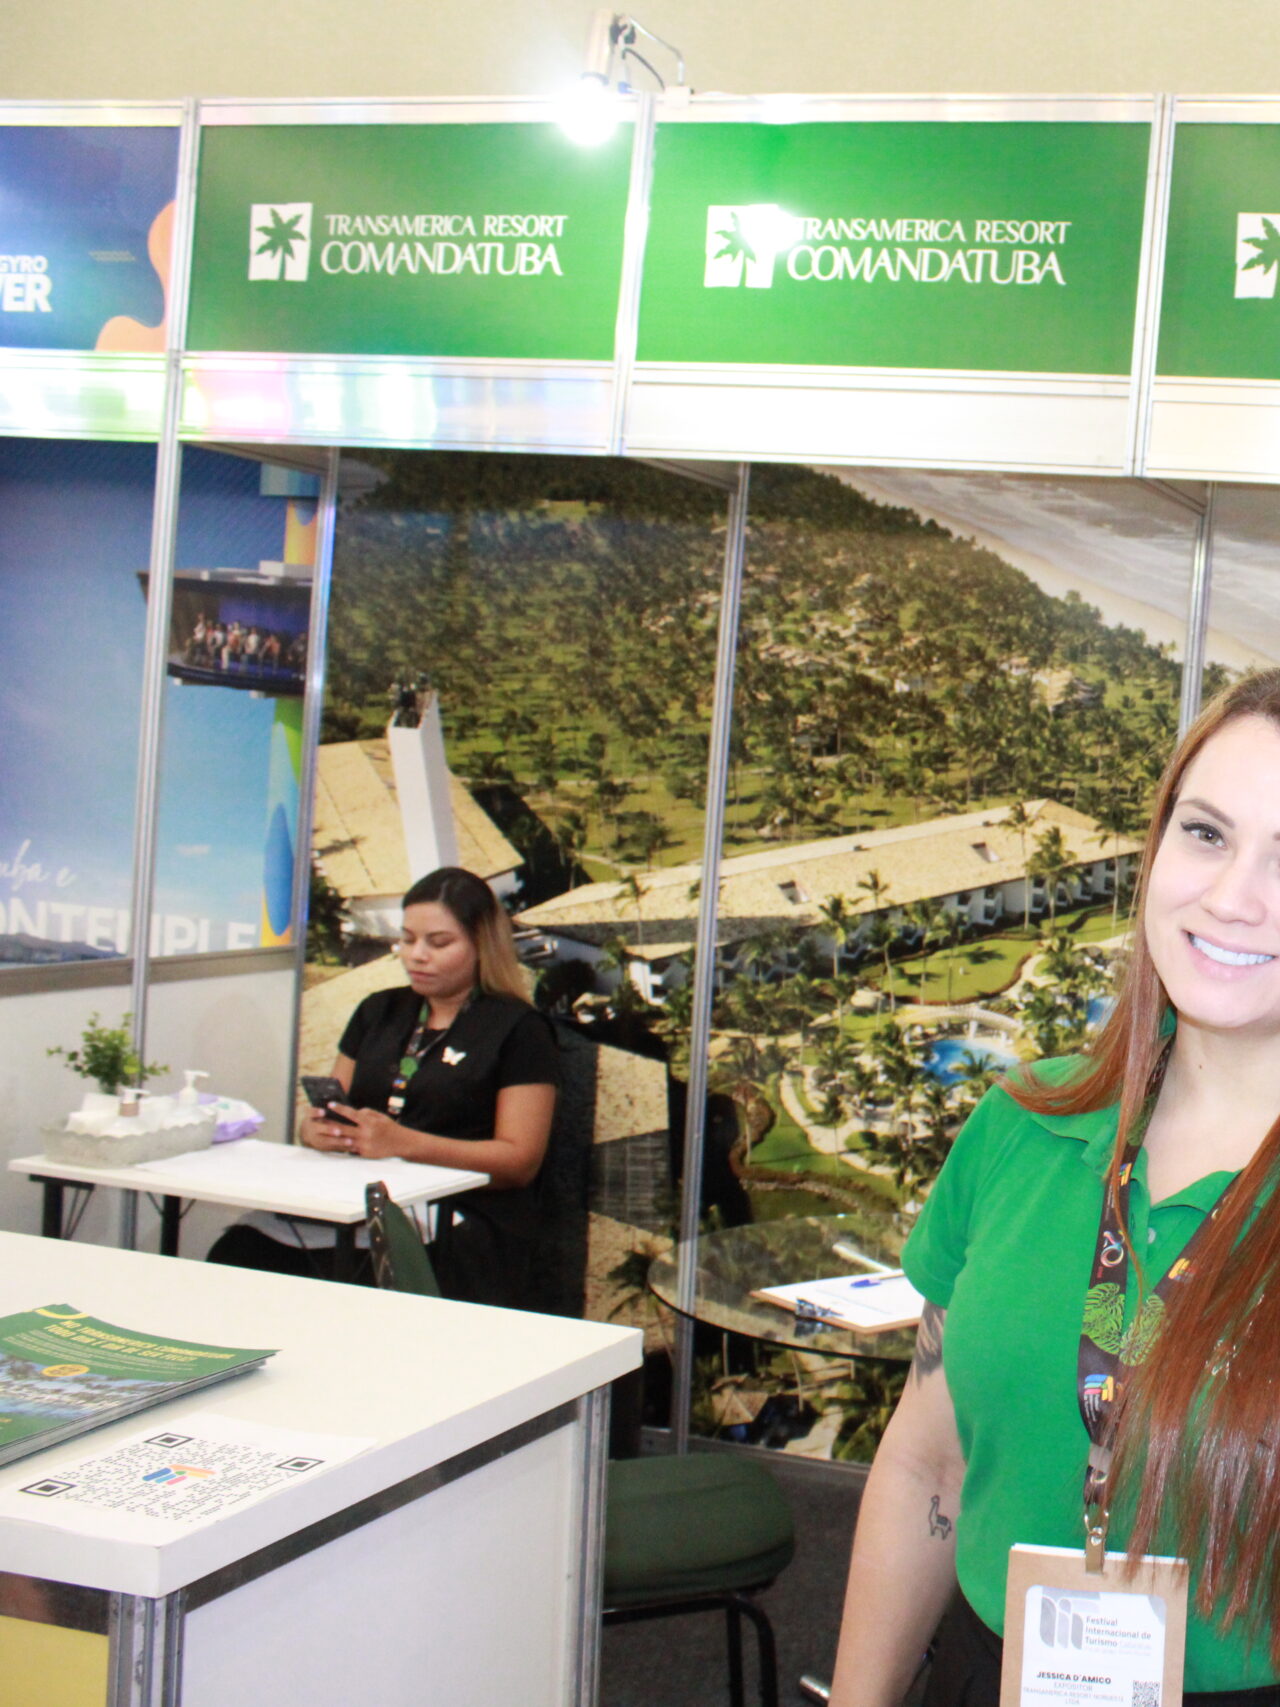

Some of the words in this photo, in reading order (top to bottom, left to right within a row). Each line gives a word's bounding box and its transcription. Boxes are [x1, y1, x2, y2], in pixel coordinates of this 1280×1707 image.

[325, 214, 475, 237] TRANSAMERICA
[483, 215, 568, 238] RESORT
[800, 217, 966, 242] TRANSAMERICA
[976, 220, 1072, 244] RESORT
[321, 241, 563, 276] COMANDATUBA
[787, 245, 1066, 285] COMANDATUBA
[1086, 1615, 1118, 1627] Festival
[1085, 1625, 1139, 1639] Internacional
[1140, 1631, 1152, 1640] de
[1085, 1636, 1118, 1647] Turismo
[1036, 1671, 1071, 1681] JESSICA
